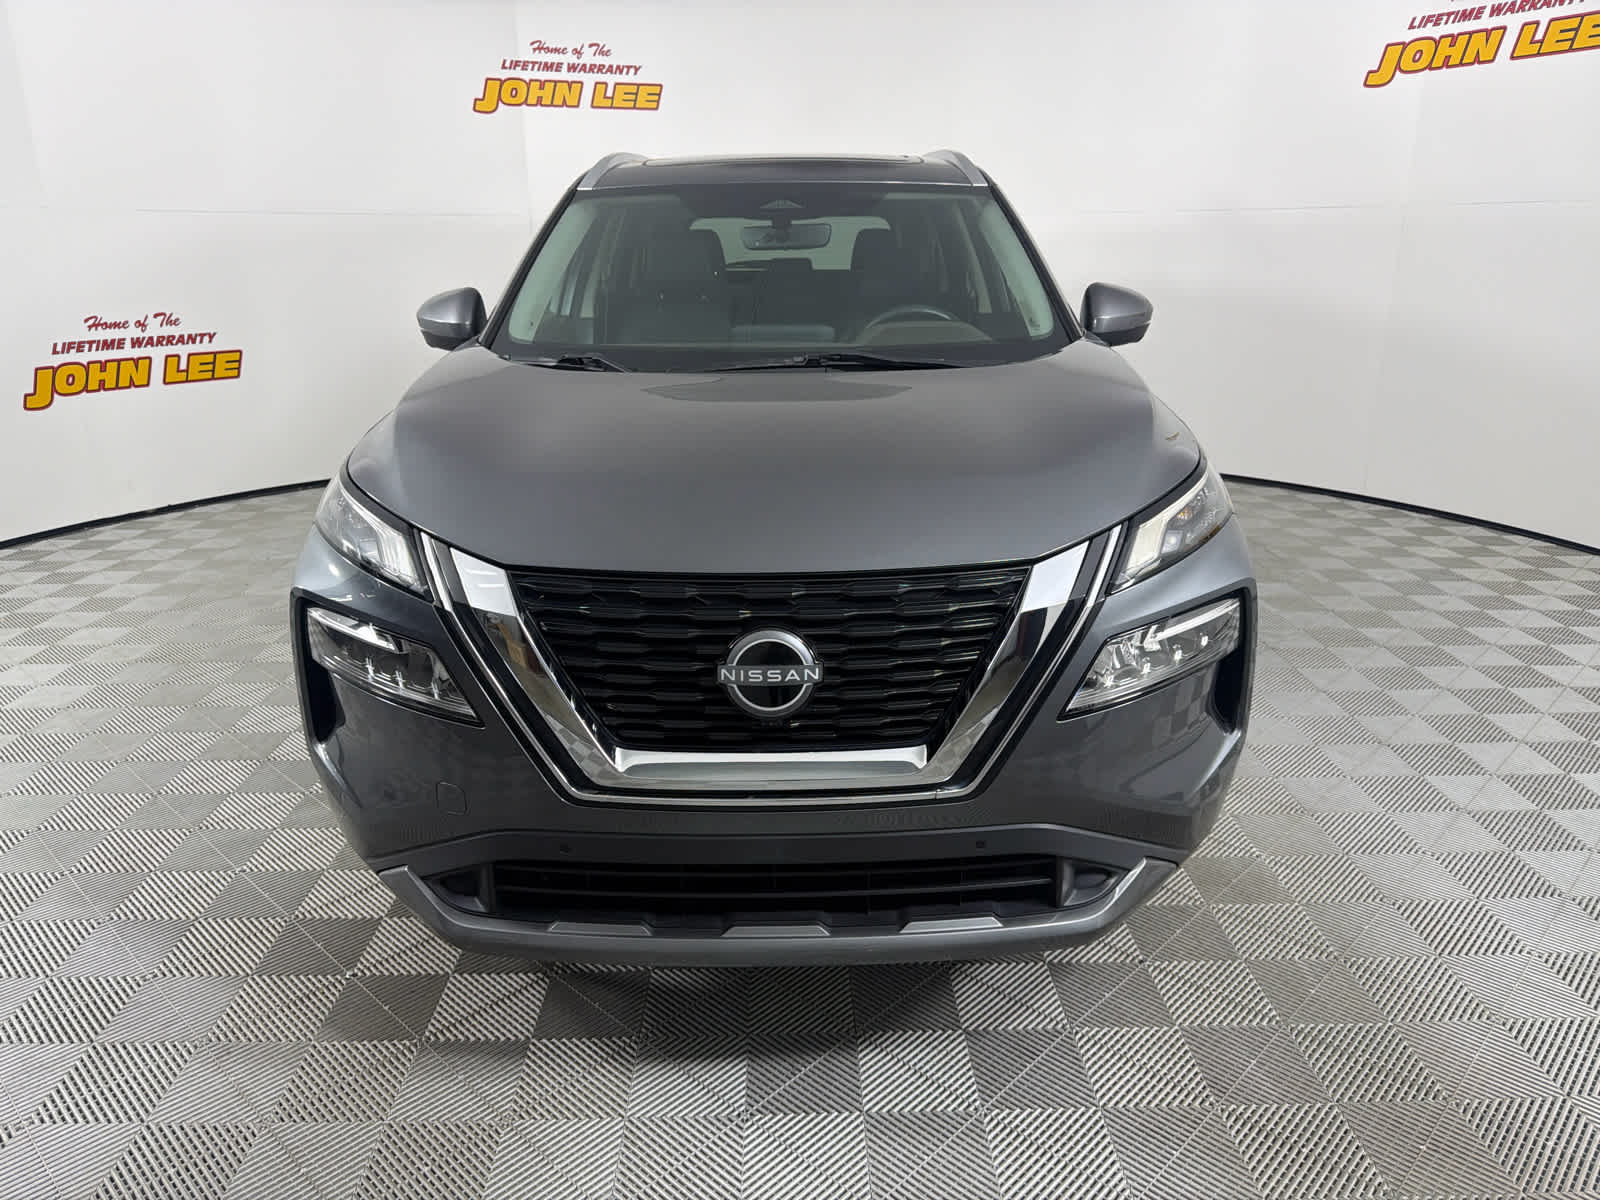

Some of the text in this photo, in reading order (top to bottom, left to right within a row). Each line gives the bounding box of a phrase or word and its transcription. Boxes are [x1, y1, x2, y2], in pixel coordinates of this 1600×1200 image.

[1408, 0, 1584, 30] LIFETIME WARRA
[529, 39, 612, 60] Home of The
[1363, 10, 1600, 88] JOHN LEE
[501, 58, 642, 76] LIFETIME WARRANTY
[473, 77, 663, 114] JOHN LEE
[83, 312, 181, 333] Home of The
[52, 332, 217, 355] LIFETIME WARRANTY
[23, 349, 242, 411] JOHN LEE
[720, 667, 819, 683] NISSAN
